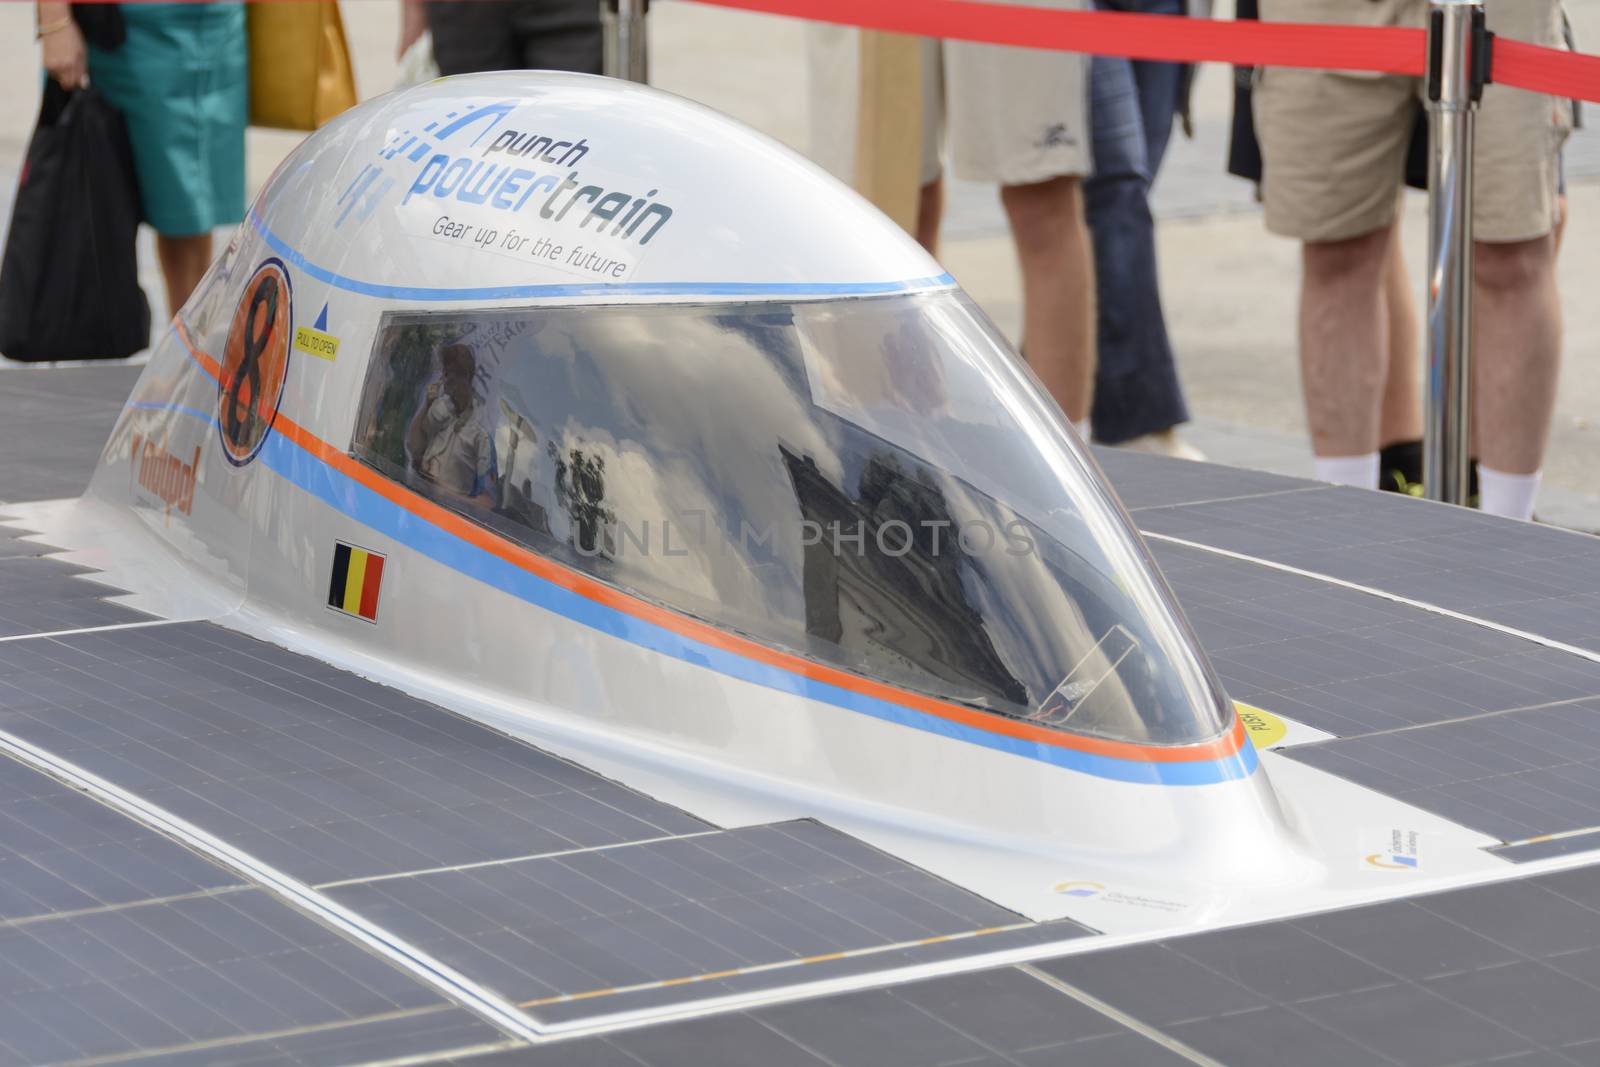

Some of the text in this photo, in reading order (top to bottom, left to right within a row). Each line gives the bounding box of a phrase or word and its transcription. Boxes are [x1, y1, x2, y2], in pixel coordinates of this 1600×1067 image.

[482, 130, 590, 167] punch
[432, 215, 627, 279] Gear up for the future
[296, 331, 336, 355] PULL TO OPEN
[231, 277, 278, 448] 8
[1240, 713, 1271, 730] PUSH
